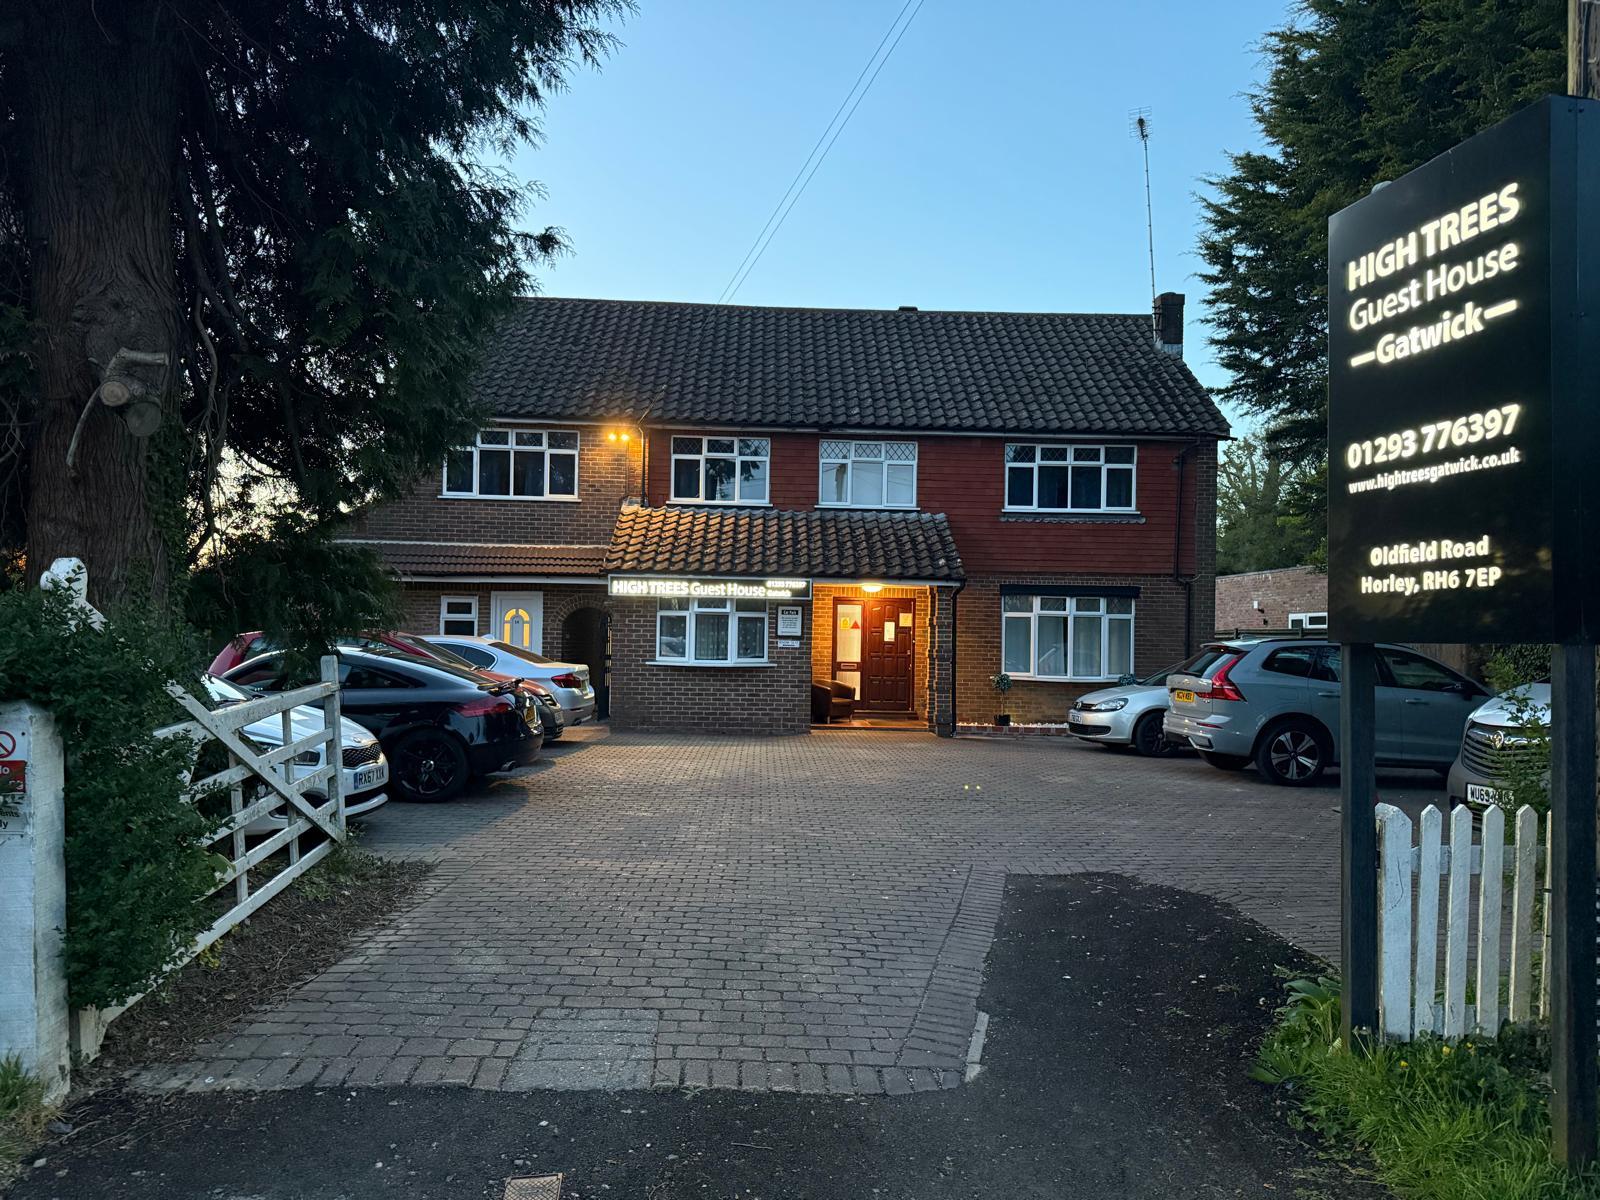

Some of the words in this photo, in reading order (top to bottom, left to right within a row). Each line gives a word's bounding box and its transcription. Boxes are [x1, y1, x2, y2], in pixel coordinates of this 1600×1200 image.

[1348, 231, 1418, 292] HIGH
[1420, 182, 1520, 257] TREES
[1349, 279, 1422, 331] Guest
[1426, 242, 1519, 301] House
[1347, 429, 1417, 469] 01293
[1420, 404, 1520, 453] 776397
[1348, 446, 1520, 494] www.hightreesgatwick.co.uk
[1370, 541, 1437, 567] Oldfield
[1441, 535, 1490, 559] Road
[612, 580, 648, 594] HIGH
[649, 581, 689, 595] TREES
[690, 582, 725, 596] Guest
[727, 583, 766, 597] House
[1361, 574, 1420, 596] Horley,
[1423, 570, 1460, 591] RH6
[1465, 566, 1502, 588] 7EP
